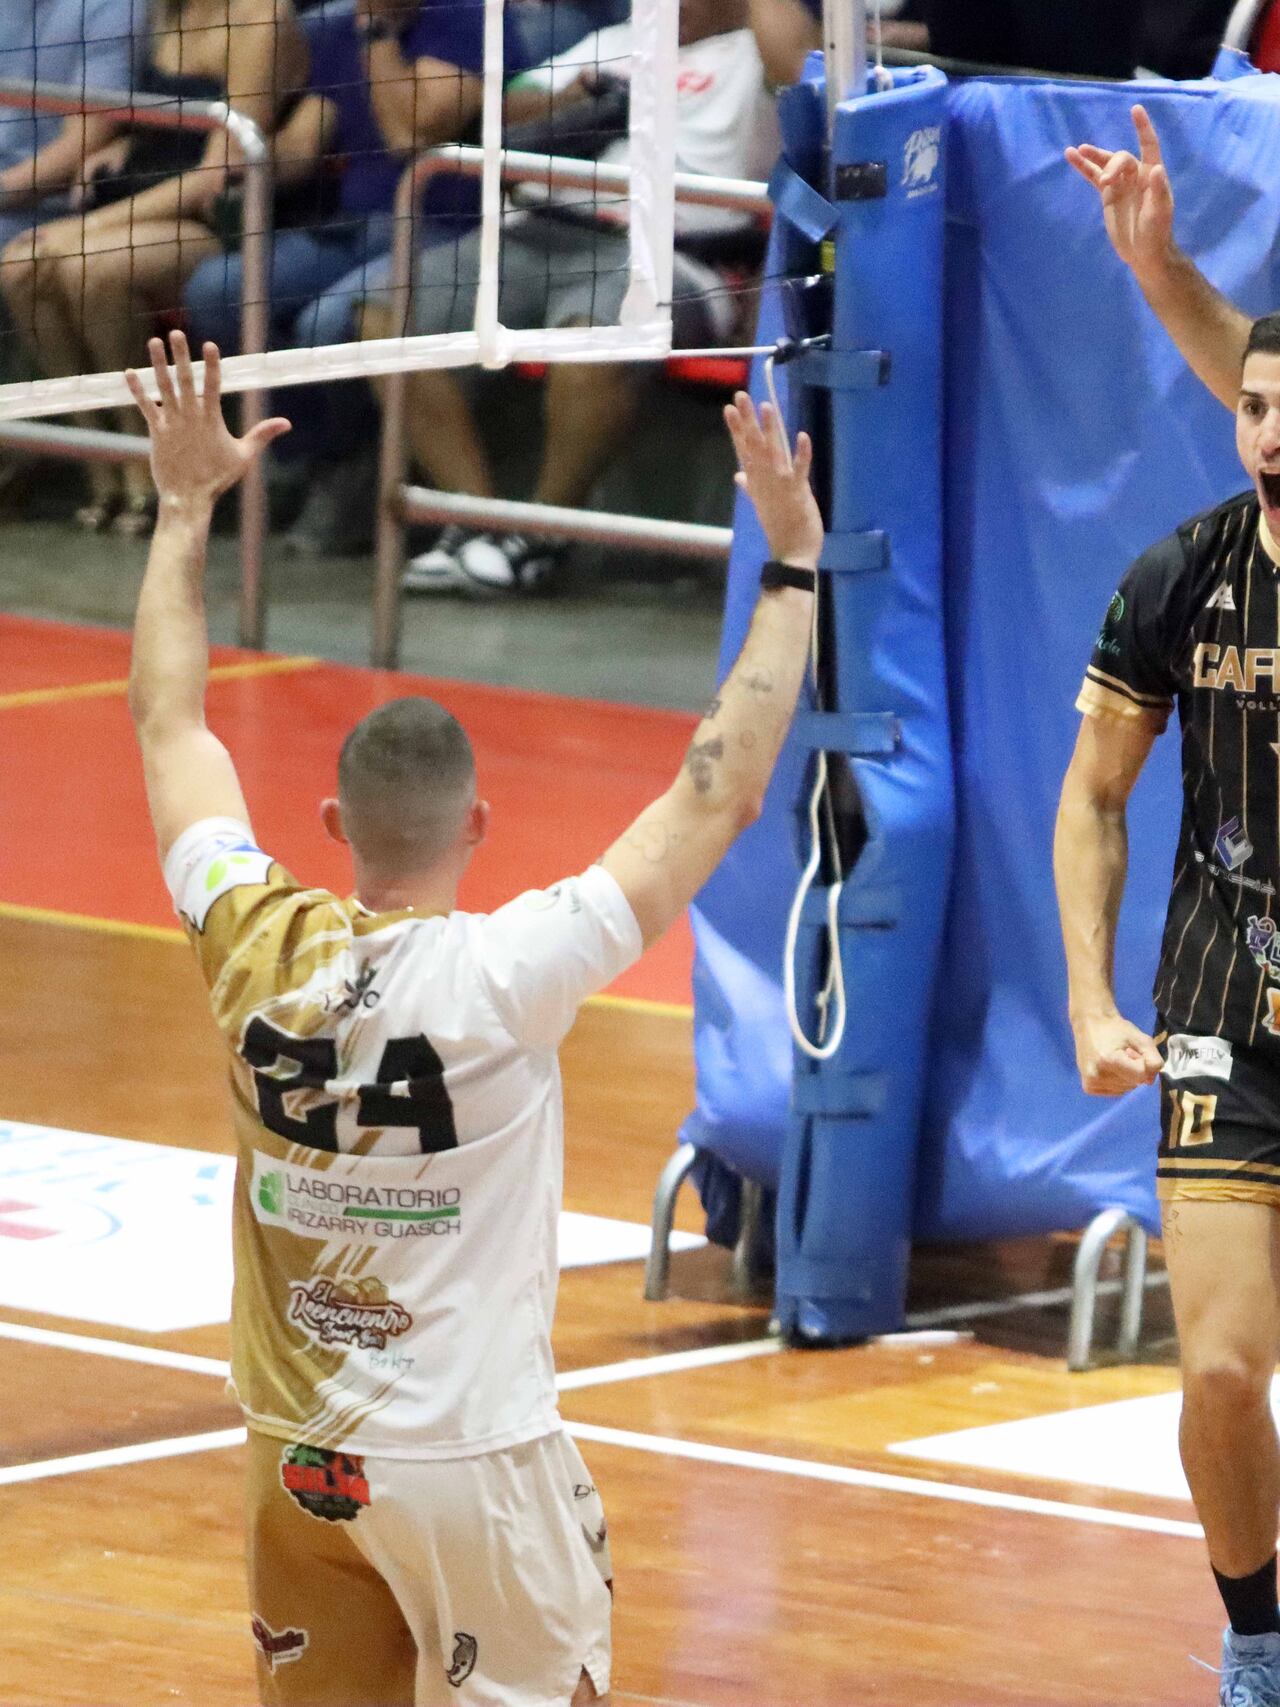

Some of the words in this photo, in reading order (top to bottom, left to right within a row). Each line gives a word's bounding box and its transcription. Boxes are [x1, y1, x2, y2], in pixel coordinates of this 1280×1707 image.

[239, 1014, 459, 1154] 24
[1168, 1089, 1218, 1149] 10
[287, 1174, 461, 1208] LABORATORIO
[374, 1220, 461, 1239] GUASCH
